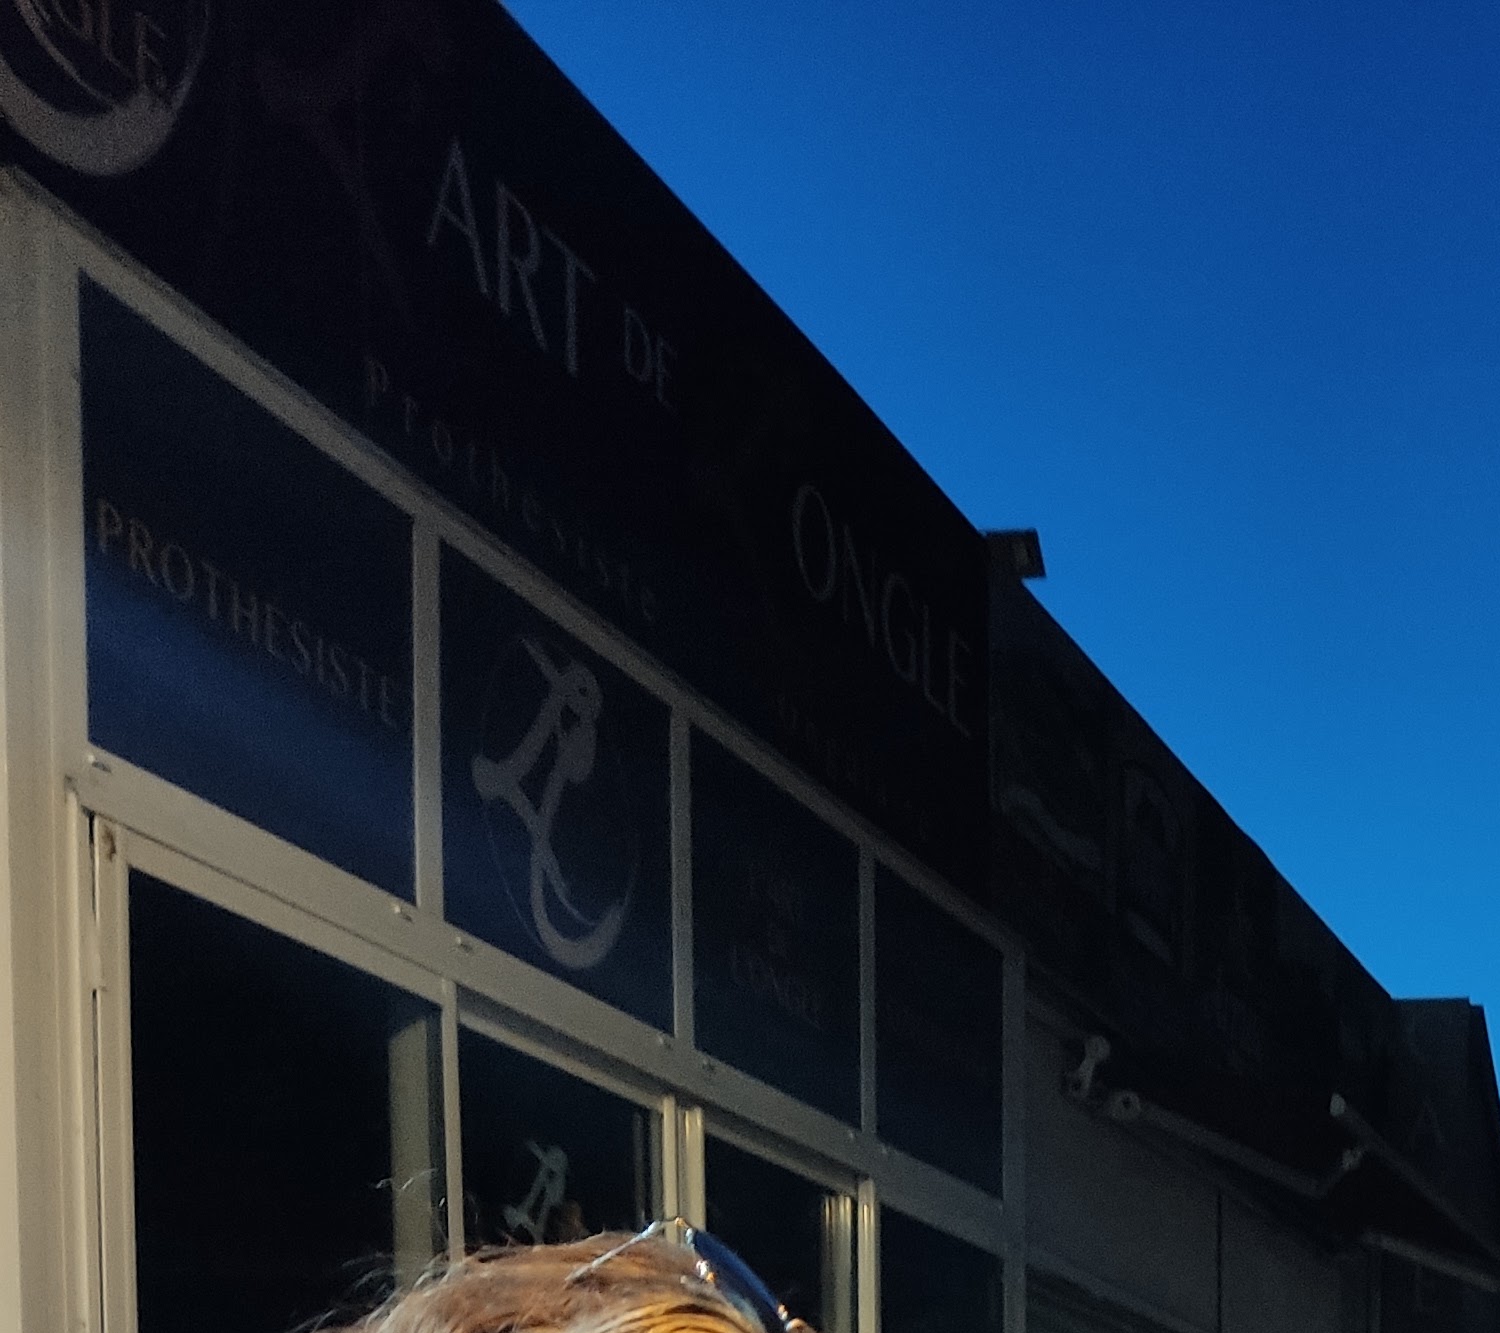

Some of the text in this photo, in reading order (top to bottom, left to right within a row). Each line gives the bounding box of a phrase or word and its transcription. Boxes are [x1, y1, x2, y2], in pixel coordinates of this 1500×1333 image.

[98, 500, 401, 733] PROTHESISTE
[426, 133, 973, 740] ART DE ONGLE
